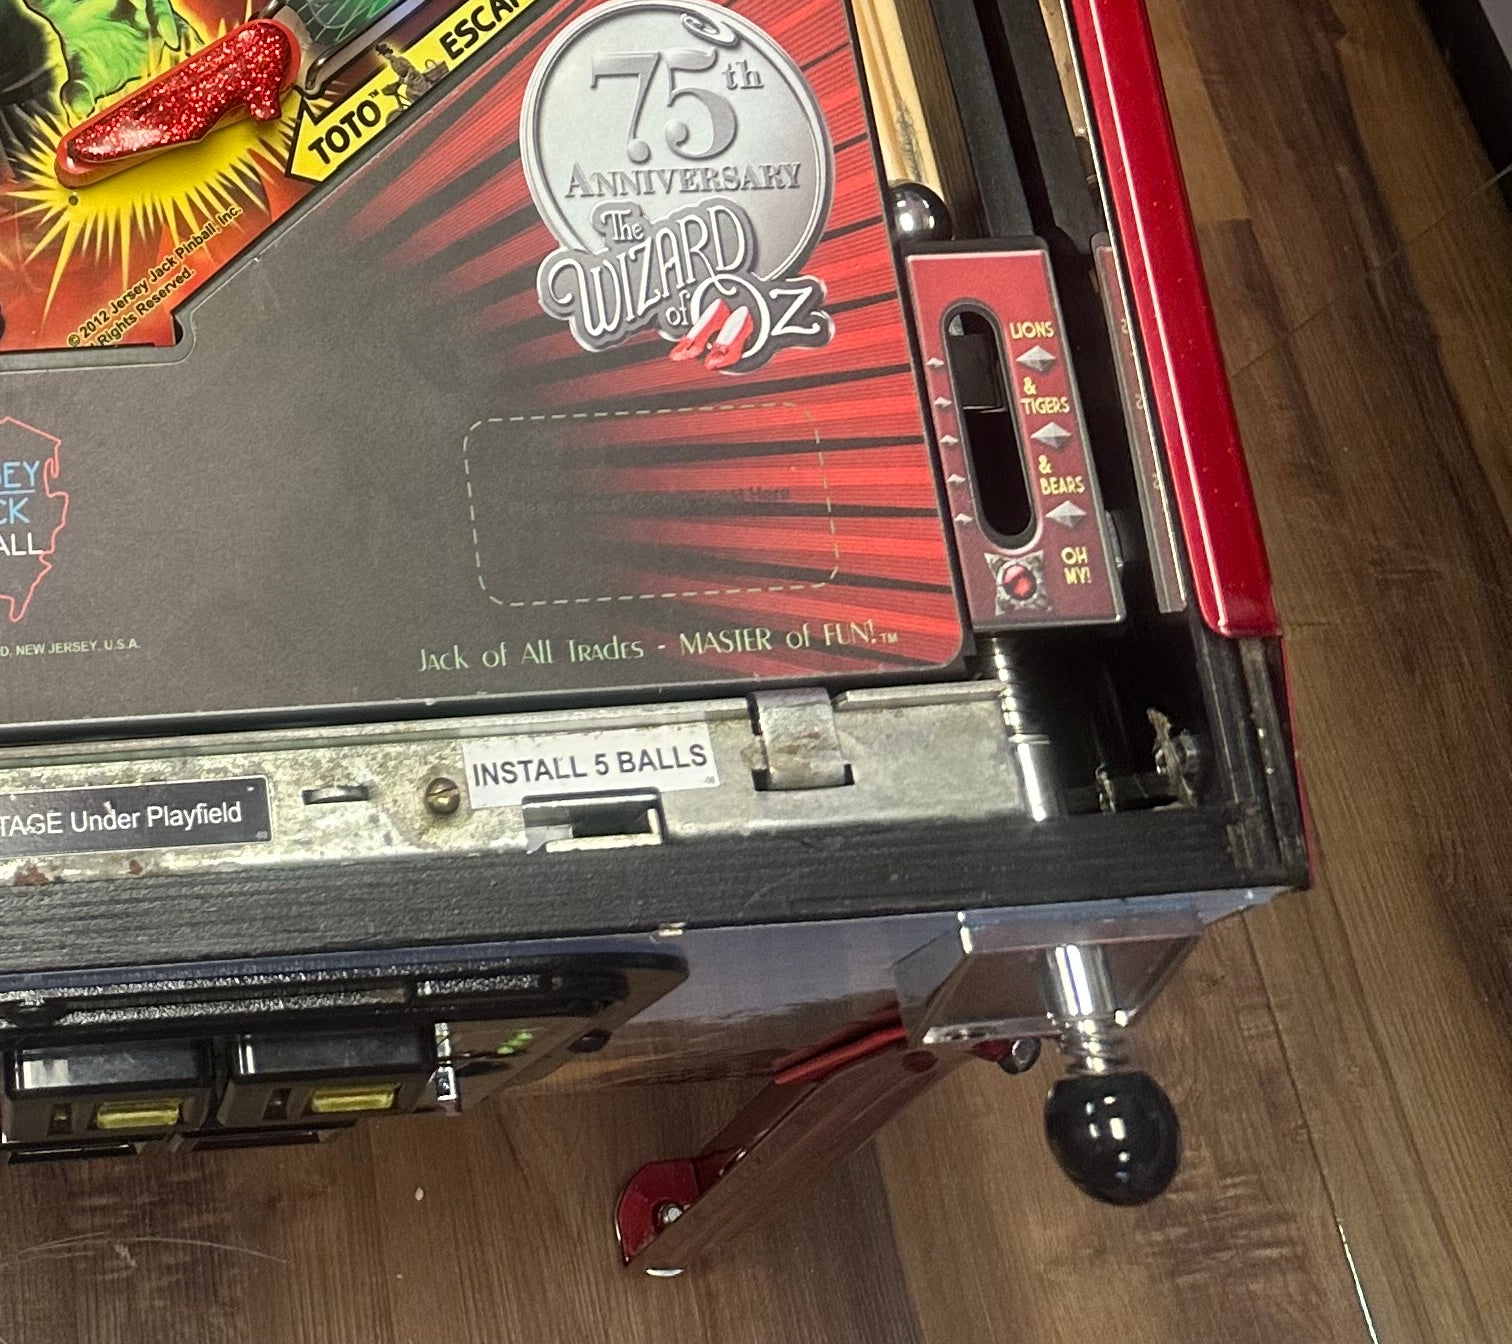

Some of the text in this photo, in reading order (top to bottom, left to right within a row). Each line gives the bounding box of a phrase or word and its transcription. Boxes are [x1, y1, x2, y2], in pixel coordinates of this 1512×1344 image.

[564, 161, 802, 199] ANNIVERSARY
[600, 208, 645, 242] The
[79, 310, 112, 339] 2012
[109, 279, 150, 315] Jersey
[149, 256, 178, 284] Jack
[217, 206, 243, 228] Inc.
[548, 204, 747, 337] WIZARD
[96, 267, 196, 347] Rights Reserved.
[1009, 320, 1055, 340] LIONS
[1023, 376, 1037, 395] &
[1020, 396, 1071, 416] TIGERS
[1038, 454, 1053, 475] &
[1039, 475, 1086, 496] BEARS
[1060, 546, 1088, 565] OH
[1063, 566, 1092, 585] MY!
[14, 642, 46, 657] NEW
[481, 646, 508, 669] of
[520, 638, 553, 666] All
[679, 626, 772, 656] MASTER
[785, 623, 811, 650] of
[823, 618, 878, 647] FUN!
[471, 742, 709, 788] INSTALL 5 BALLS
[69, 808, 142, 833] Under
[147, 799, 243, 834] Playfield
